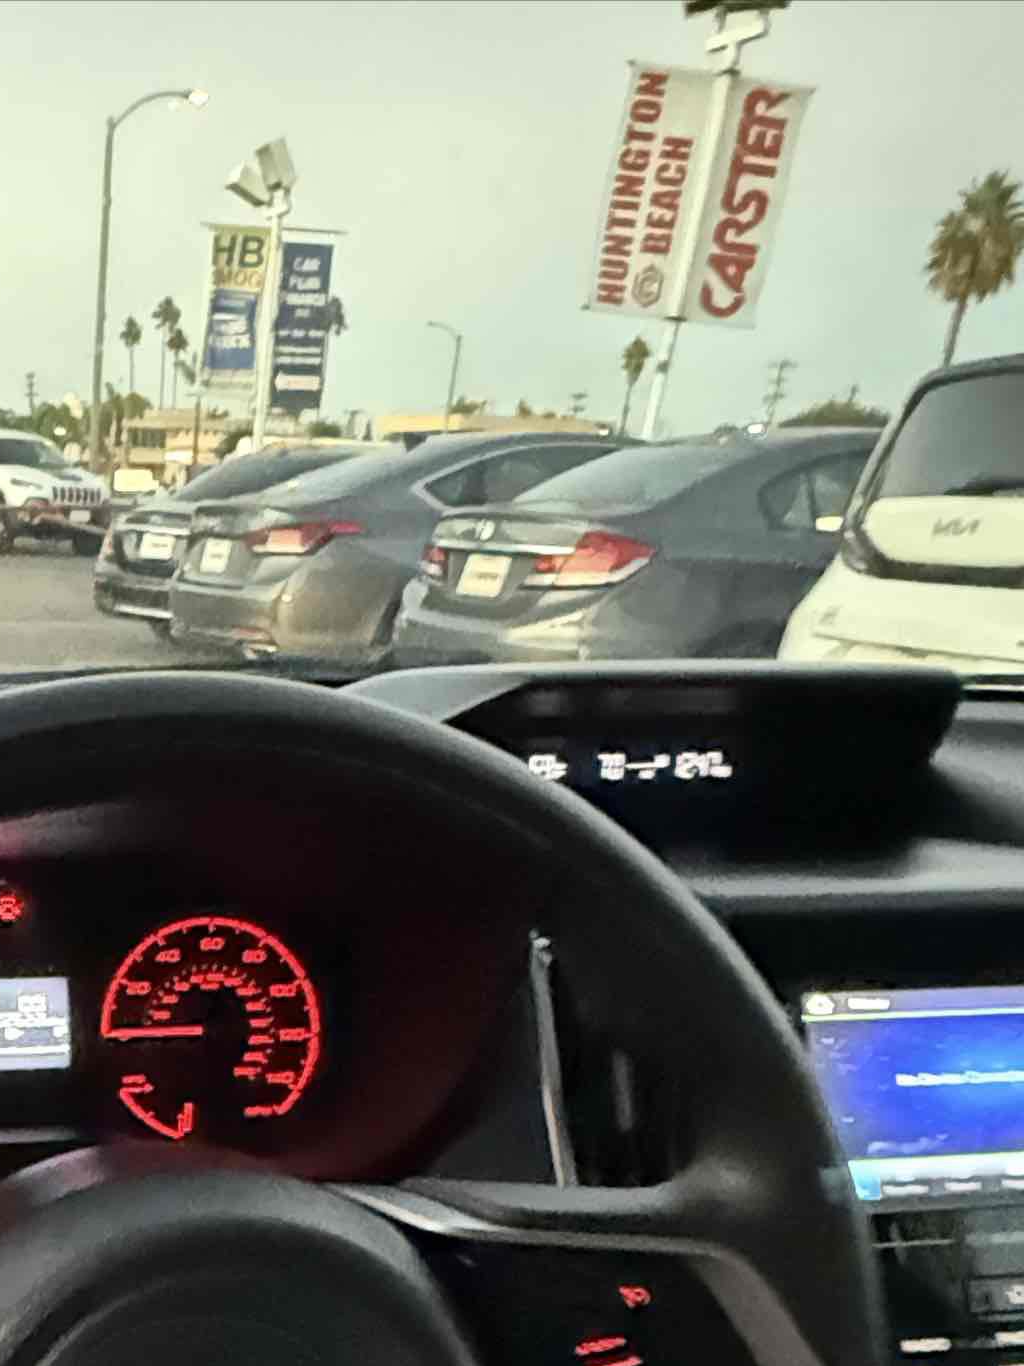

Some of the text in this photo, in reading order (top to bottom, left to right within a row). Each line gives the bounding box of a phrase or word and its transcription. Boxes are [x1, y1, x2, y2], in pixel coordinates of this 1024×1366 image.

[212, 233, 265, 268] HB
[596, 72, 670, 306] HUNTINGTON
[639, 136, 694, 256] BEACH
[699, 87, 793, 318] CARSTER
